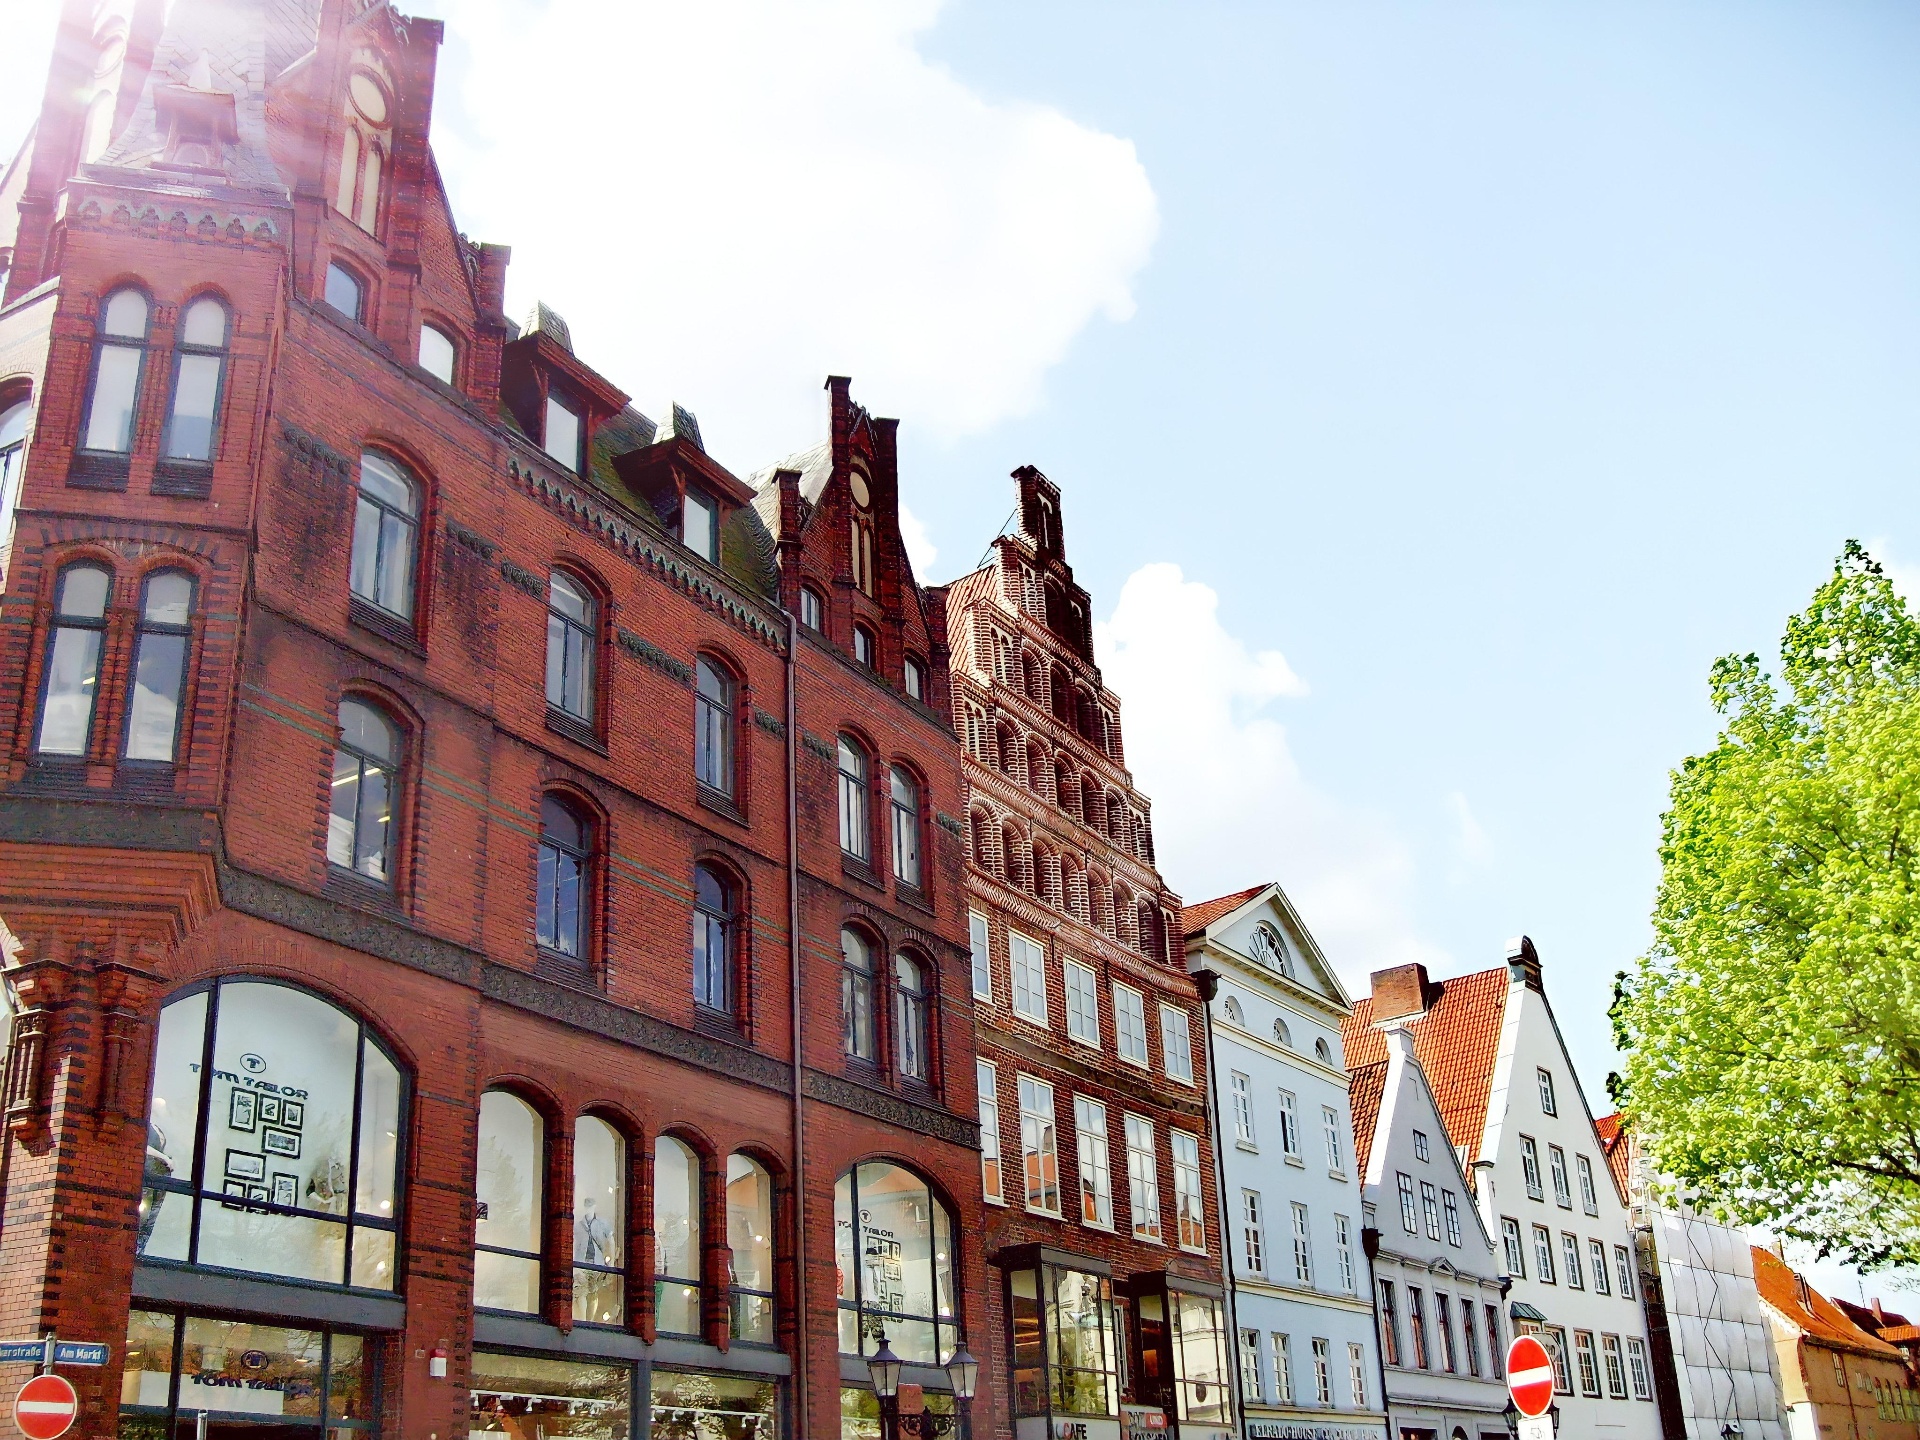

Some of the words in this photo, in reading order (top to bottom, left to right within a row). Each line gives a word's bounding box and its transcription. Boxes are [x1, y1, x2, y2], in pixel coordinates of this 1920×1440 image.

[189, 1063, 240, 1084] TM
[243, 1076, 309, 1100] TAILOR
[60, 1347, 75, 1358] Am
[75, 1348, 102, 1361] Markt
[191, 1372, 243, 1389] TOM
